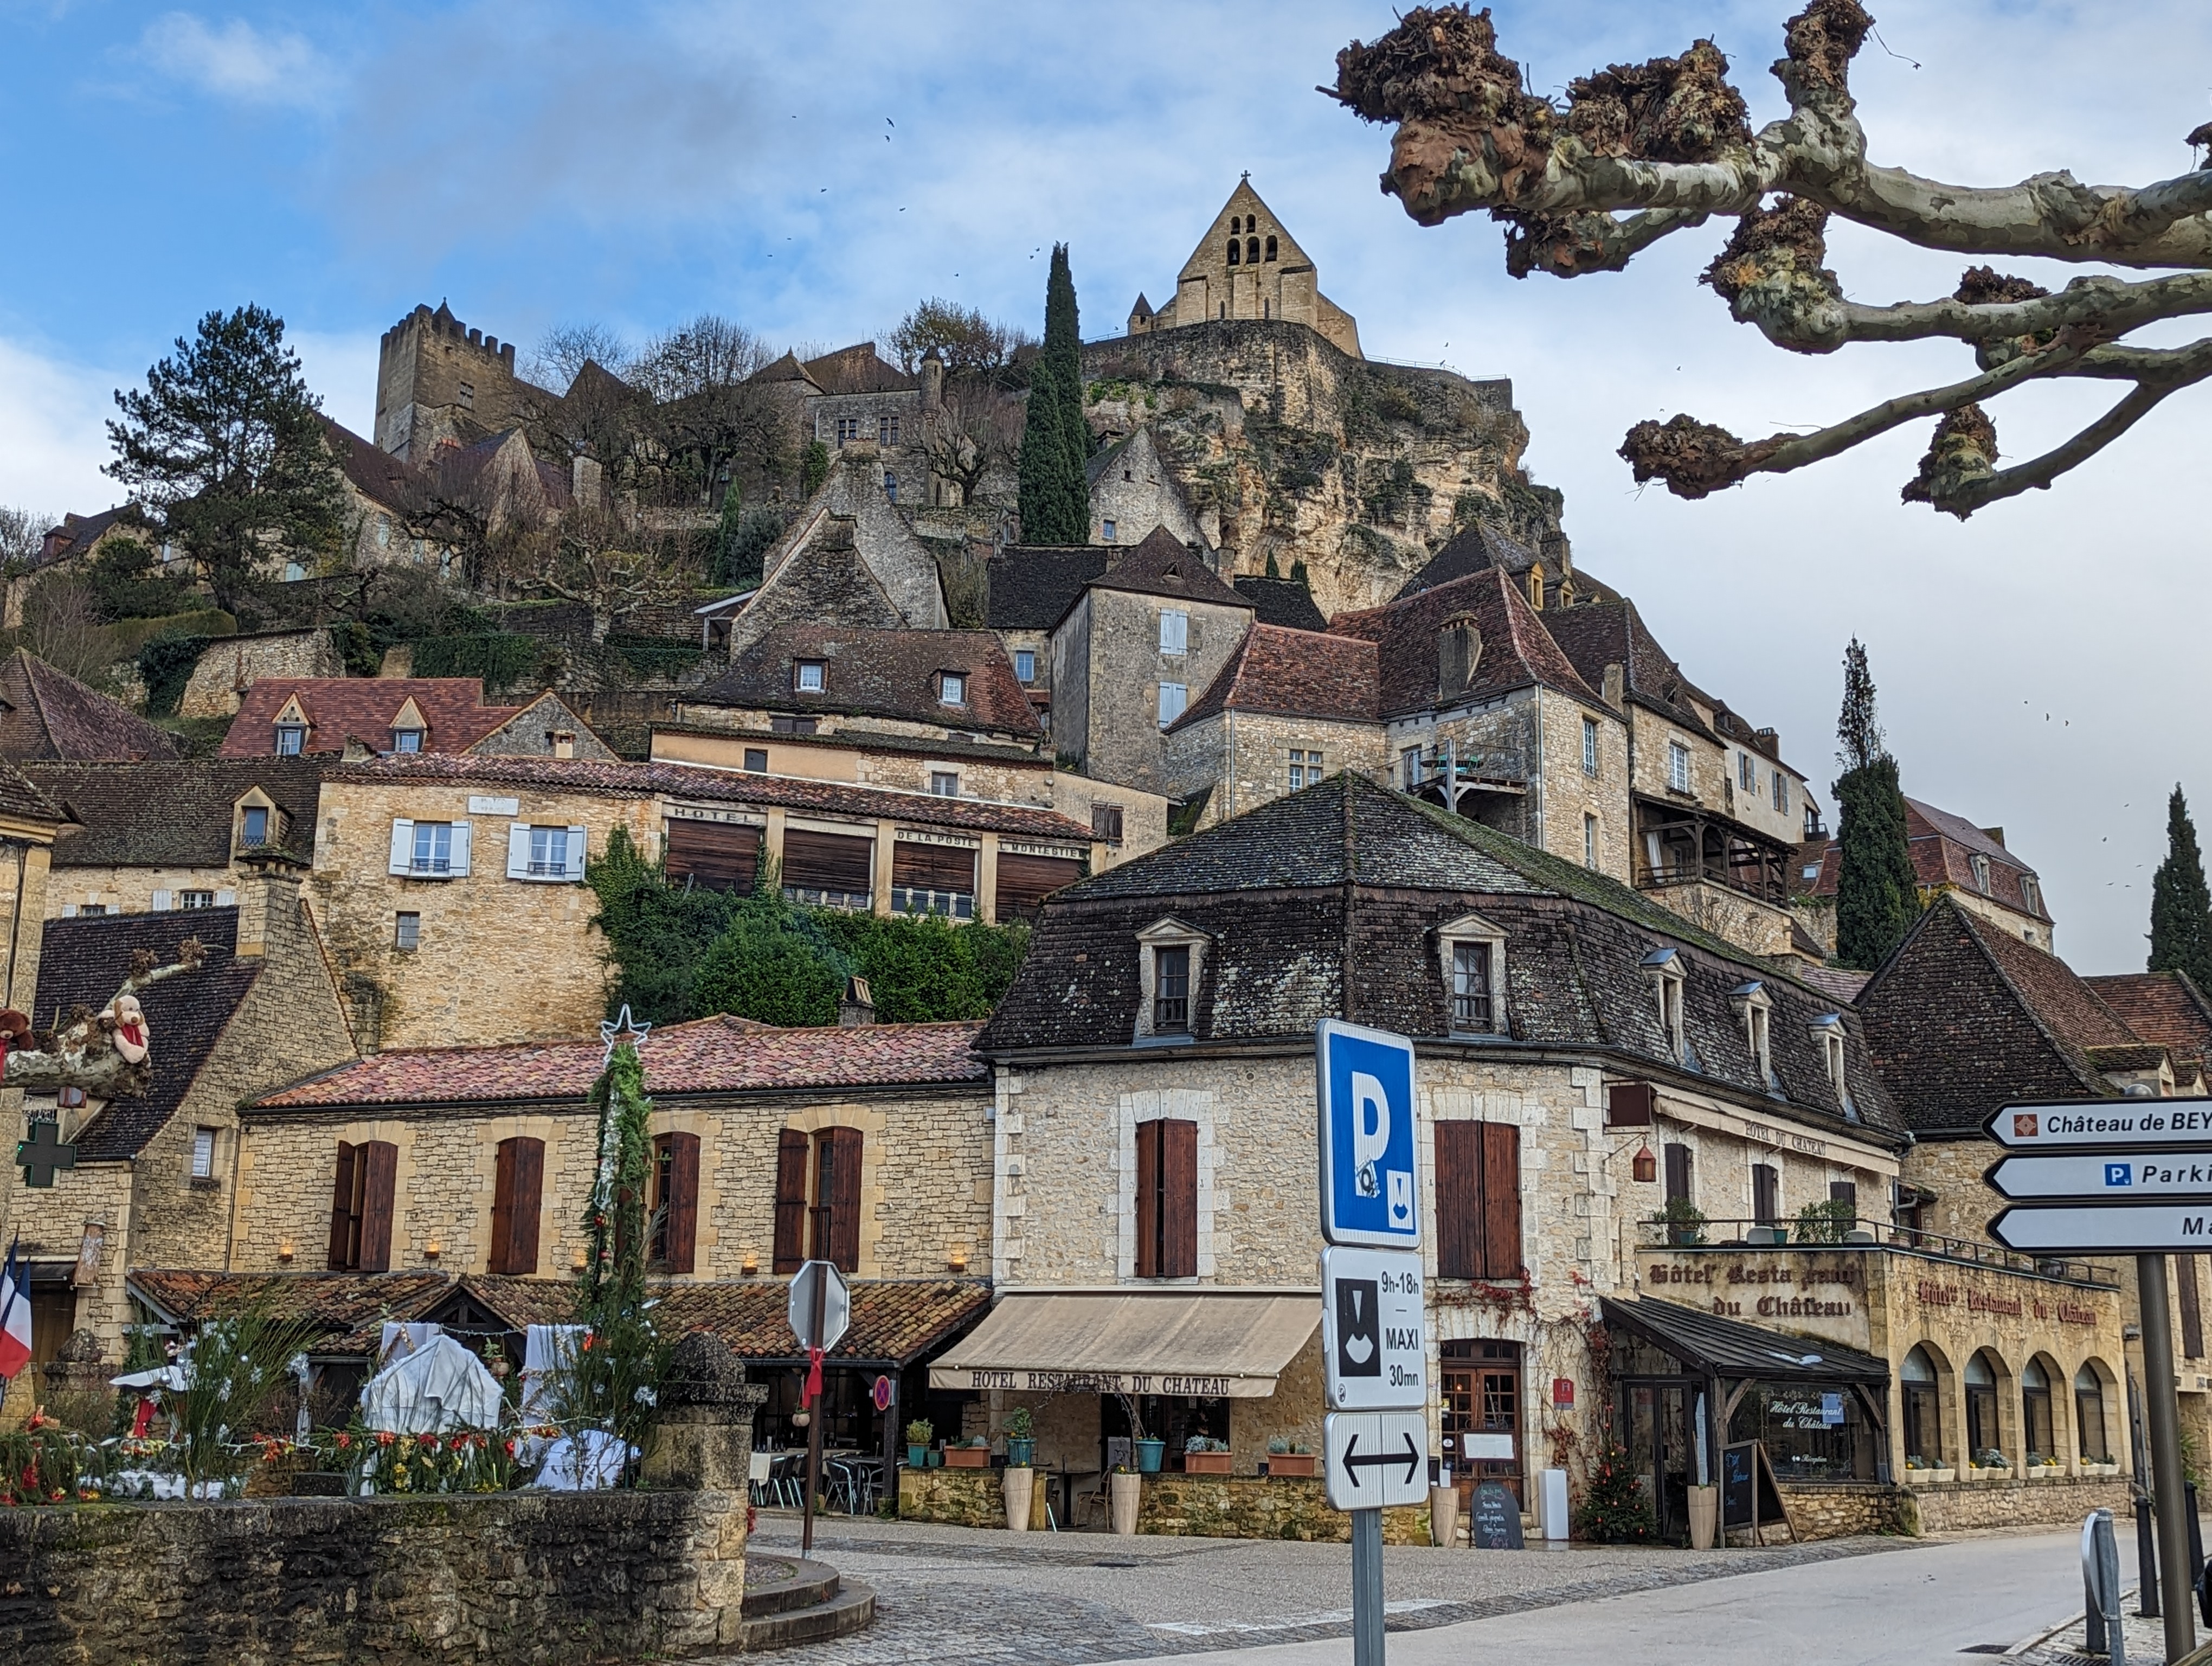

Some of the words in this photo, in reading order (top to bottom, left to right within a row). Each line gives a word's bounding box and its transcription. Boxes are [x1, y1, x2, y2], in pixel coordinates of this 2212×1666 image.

[674, 808, 752, 823] HOTEL
[897, 831, 912, 840] DE
[918, 834, 932, 842] LA
[937, 835, 975, 847] POSTE
[2048, 1115, 2133, 1133] Château
[2139, 1113, 2165, 1130] de
[2171, 1112, 2212, 1130] BEY
[1352, 1071, 1391, 1197] P
[1776, 1131, 1786, 1146] DU
[1792, 1136, 1827, 1157] CHATEAU
[2111, 1167, 2125, 1183] P
[2142, 1164, 2212, 1183] Parki
[1382, 1271, 1419, 1295] 9h-18h
[1713, 1296, 1741, 1316] du
[1756, 1296, 1851, 1317] Château
[1386, 1327, 1419, 1350] MAXI
[971, 1371, 1017, 1389] HOTEL
[1131, 1375, 1152, 1393] DU
[1162, 1376, 1230, 1396] CHATEAU
[1389, 1364, 1419, 1387] 30mn
[1769, 1400, 1797, 1414] Hôtel
[1795, 1401, 1842, 1416] Restaurant
[1782, 1417, 1795, 1428] du
[1798, 1416, 1832, 1430] Château
